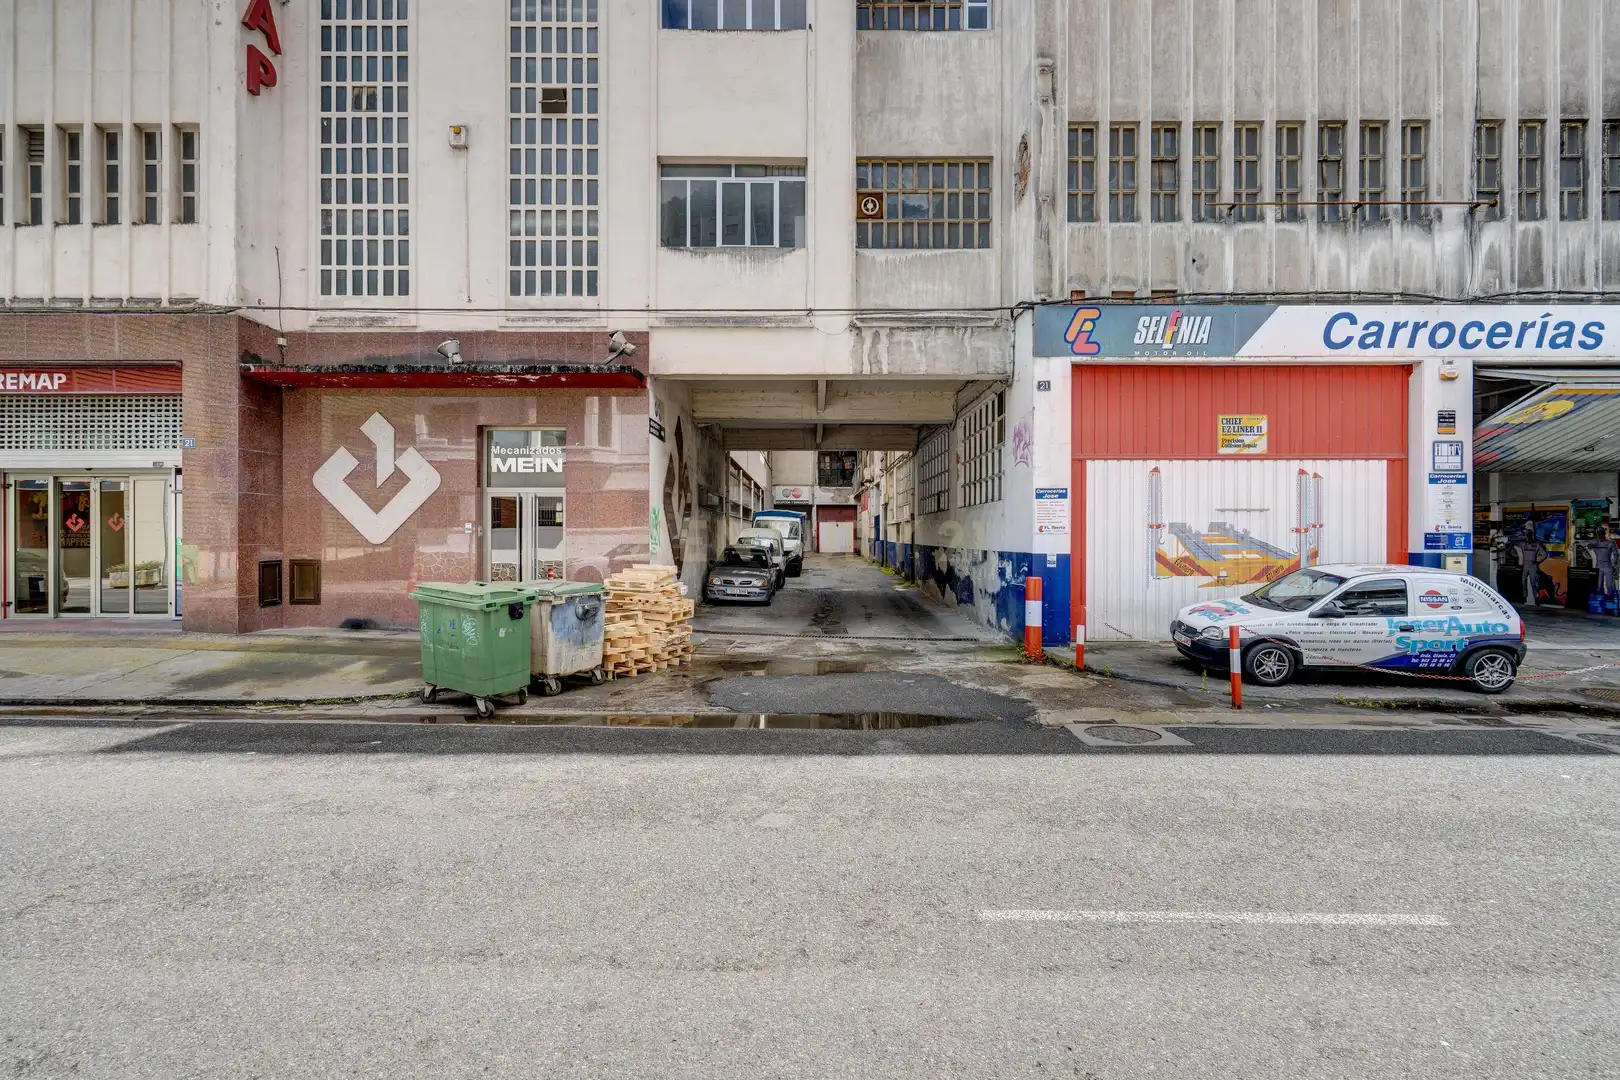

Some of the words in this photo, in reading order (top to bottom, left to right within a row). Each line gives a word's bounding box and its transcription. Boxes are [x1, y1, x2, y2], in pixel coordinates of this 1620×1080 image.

[1133, 307, 1213, 349] SELENIA
[1323, 311, 1606, 350] Carrocerías
[1039, 382, 1050, 390] 21
[1221, 417, 1243, 426] CHIEF
[491, 445, 562, 455] Mecanizados
[491, 457, 563, 473] MEIN
[1419, 595, 1448, 603] NISSAN
[1460, 577, 1511, 620] Multimarcas
[1394, 635, 1470, 655] Sport
